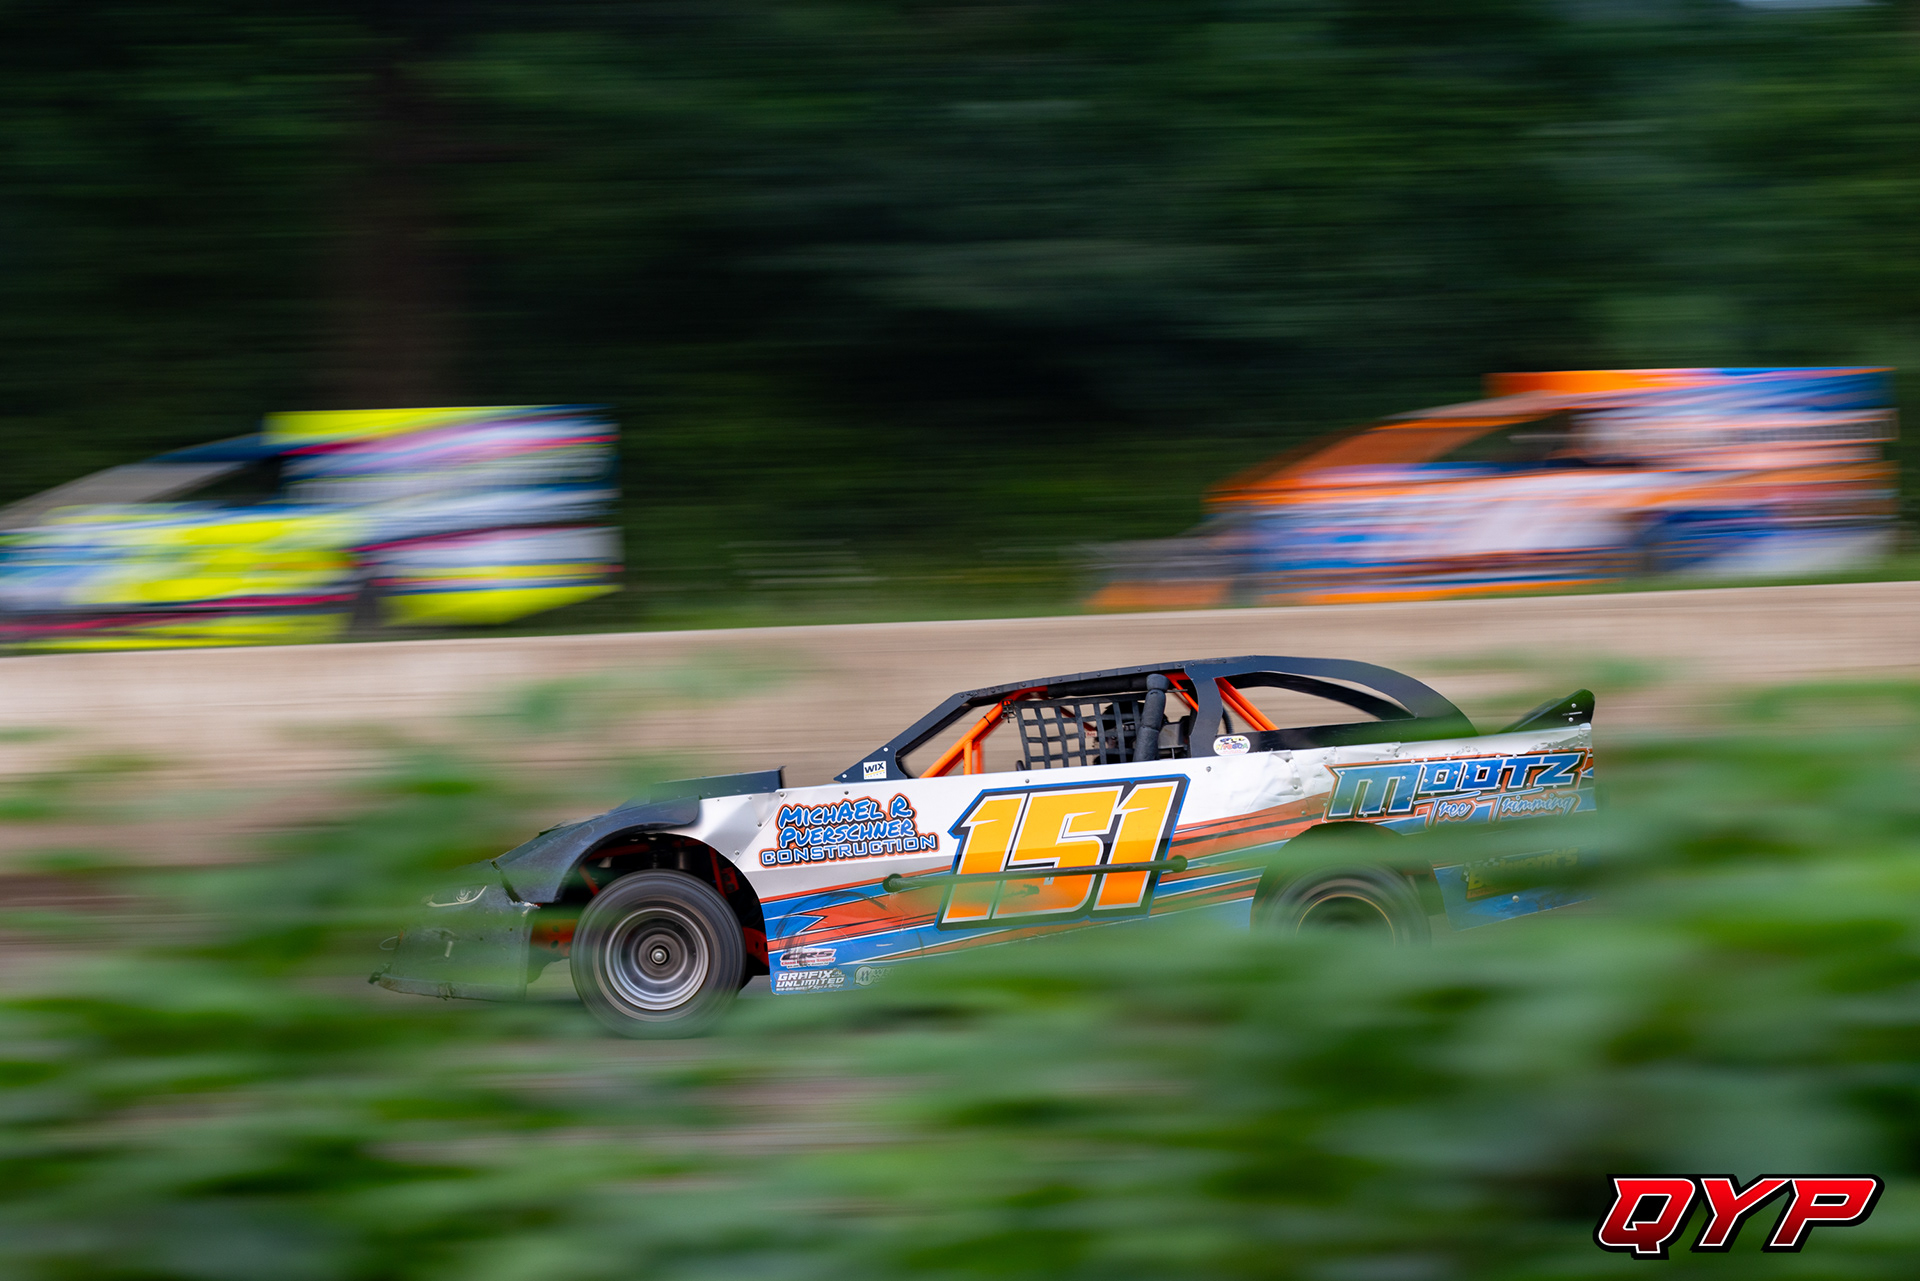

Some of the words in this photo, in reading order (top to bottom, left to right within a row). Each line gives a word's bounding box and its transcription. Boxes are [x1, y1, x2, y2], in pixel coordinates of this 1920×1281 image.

[864, 762, 885, 774] WIX
[779, 799, 884, 829] MICHAEL
[1413, 790, 1481, 827] Tree
[1476, 787, 1577, 823] Trimming
[779, 818, 916, 849] PUERSCHNER
[761, 835, 936, 865] CONSTRUCTION
[941, 780, 1180, 924] 151
[776, 976, 845, 988] UNLIMITED
[777, 970, 833, 981] GRAFIX
